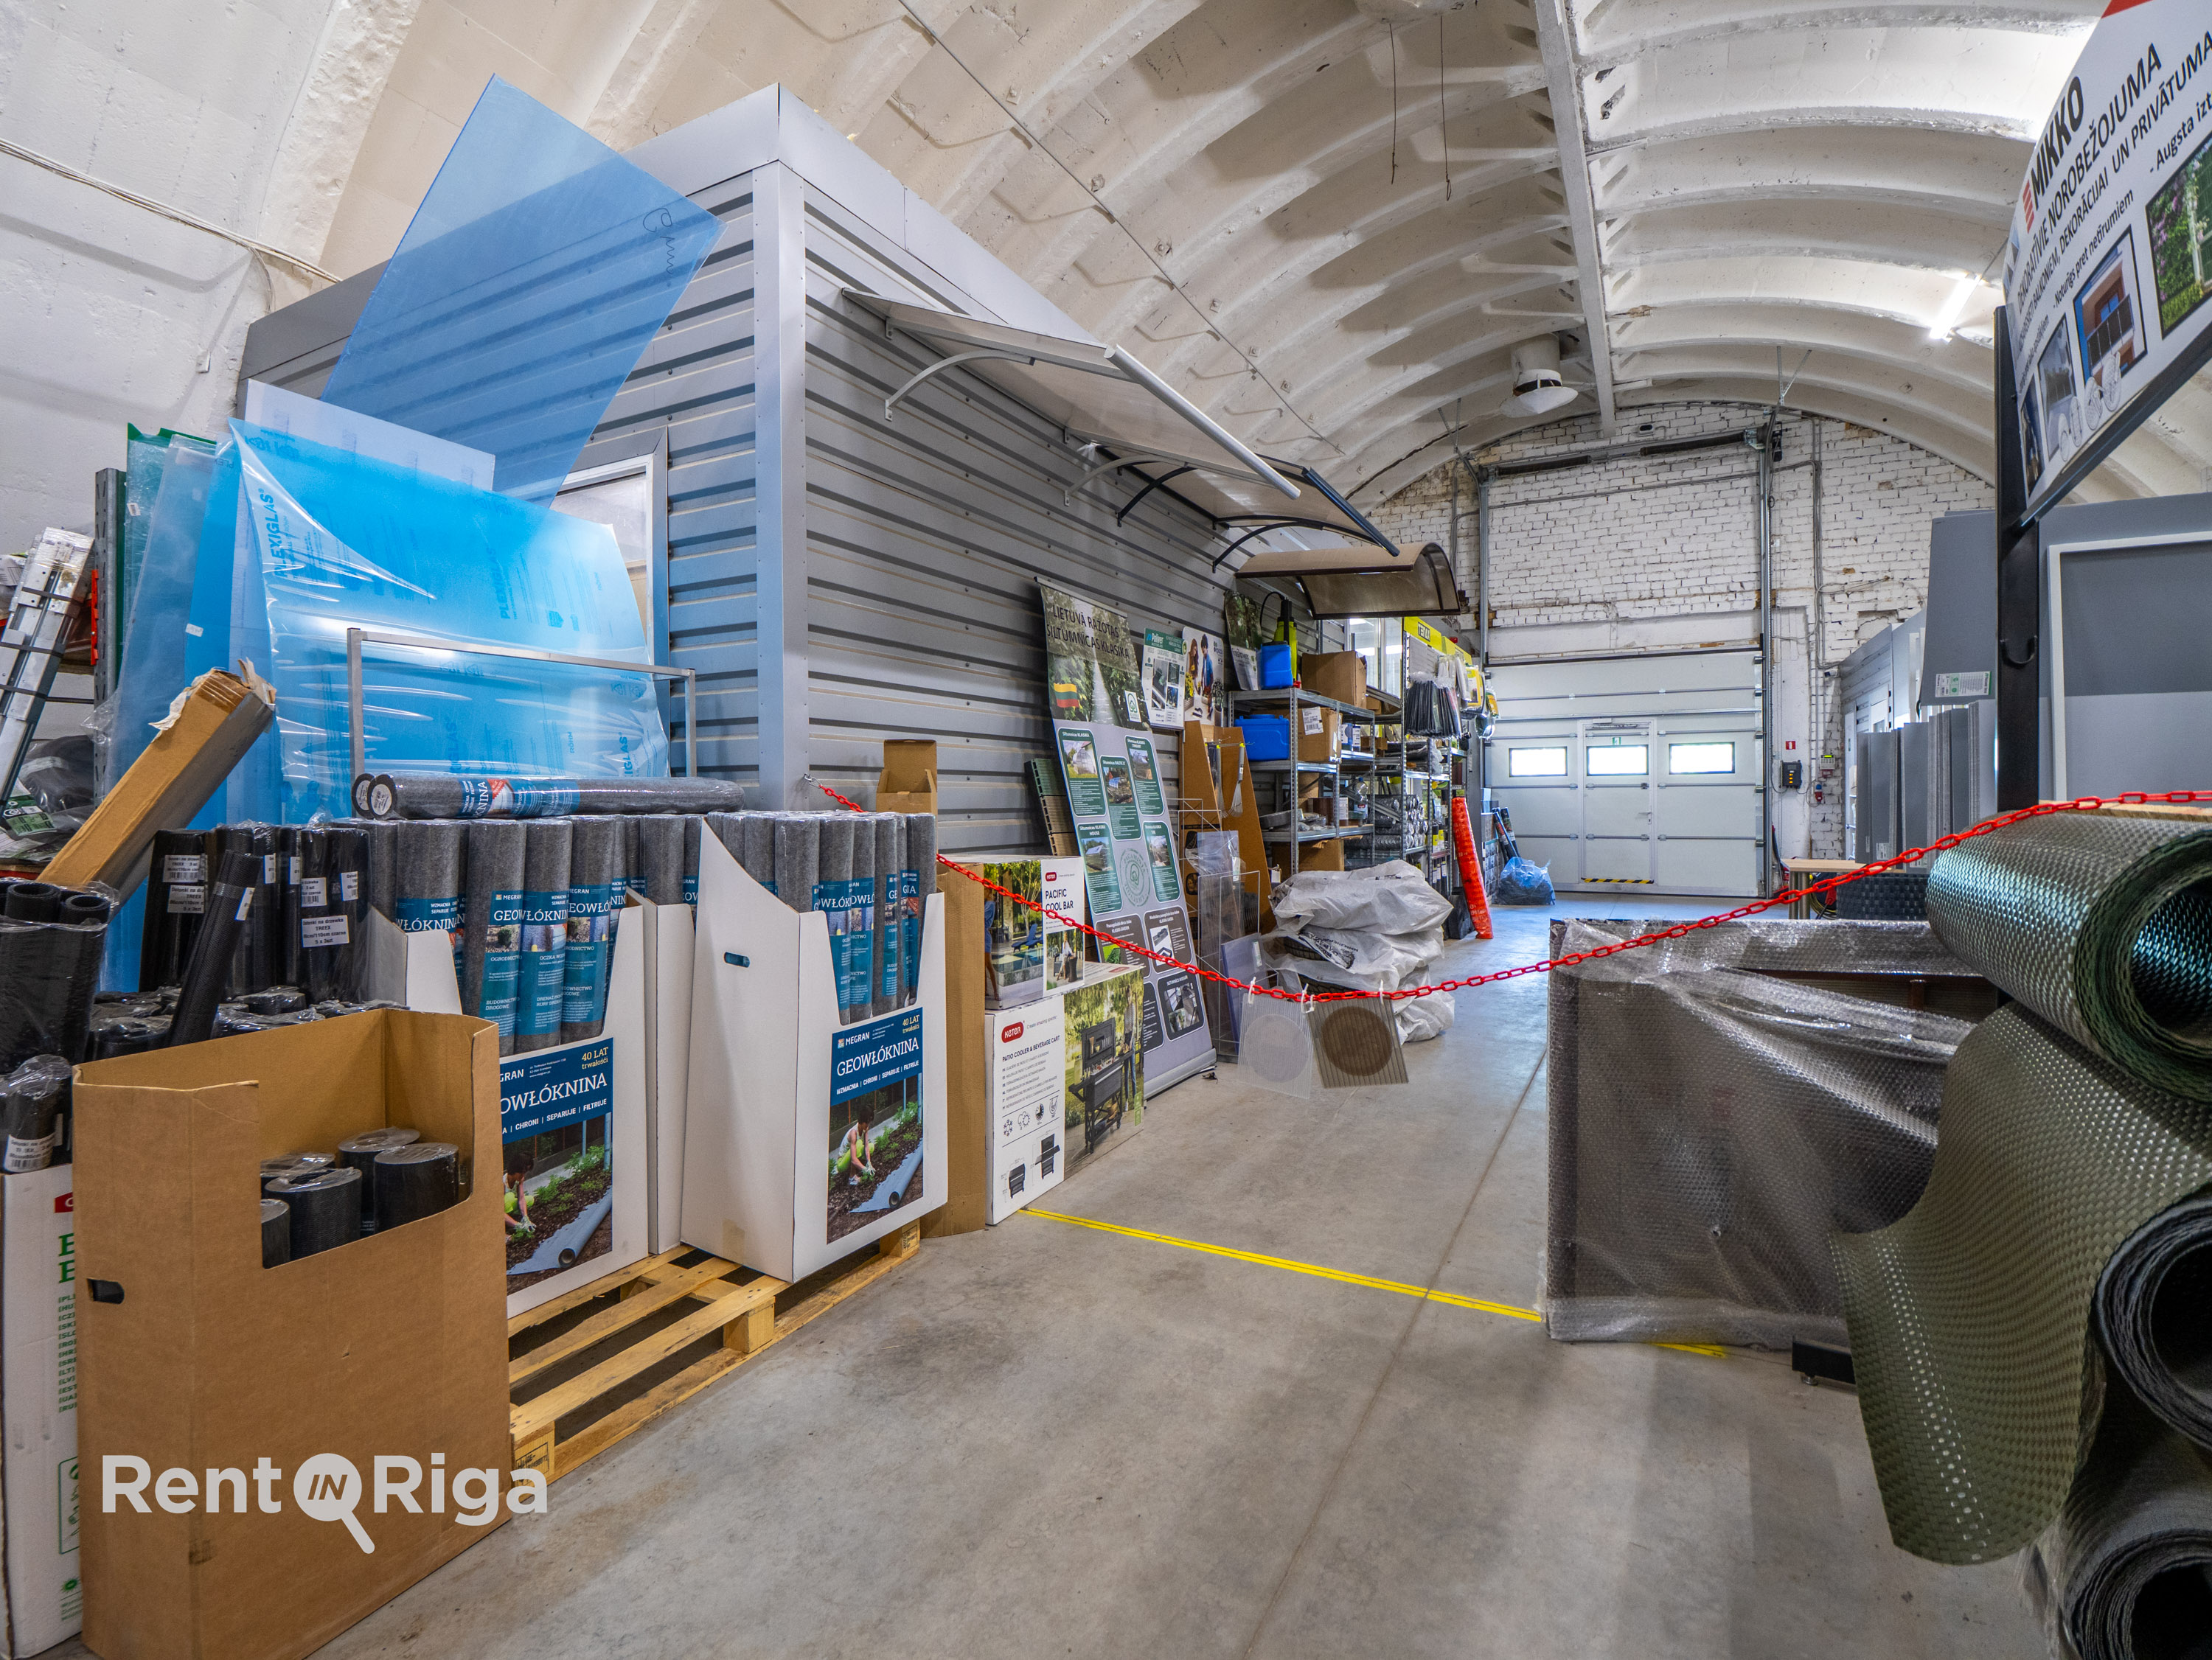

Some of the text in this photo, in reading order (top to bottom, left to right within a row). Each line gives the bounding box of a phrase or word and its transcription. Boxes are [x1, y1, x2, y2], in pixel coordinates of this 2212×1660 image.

[2031, 76, 2084, 211] MIKKO
[2048, 43, 2162, 234] NOROBEŽOJUMA
[2157, 116, 2194, 170] Augsta
[2059, 167, 2109, 254] DEKORĀCIJAI
[2112, 137, 2129, 173] UN
[2076, 247, 2089, 278] pret
[2089, 189, 2134, 256] netīrumiem
[1053, 605, 1087, 627] LIETUVĀ
[1101, 640, 1130, 659] KLASIKA
[1046, 888, 1067, 899] PACIFIC
[1046, 900, 1074, 911] COOL BAR
[902, 1014, 919, 1026] 40 LAT
[845, 1032, 870, 1046] MEGRAN
[1002, 1053, 1014, 1062] PATIO
[1014, 1047, 1029, 1057] COOLER
[1033, 1039, 1051, 1050] BEVERAGE
[1051, 1035, 1060, 1044] CART
[582, 1047, 609, 1061] 40 LAT
[837, 1037, 919, 1076] GEOWŁÓKNINA
[836, 1082, 859, 1095] WZMACNIA
[882, 1067, 900, 1078] SEPARUJE
[904, 1060, 919, 1071] FILTRUJE
[515, 1098, 607, 1130] CHRONI SEPARUJE FILTRUJE
